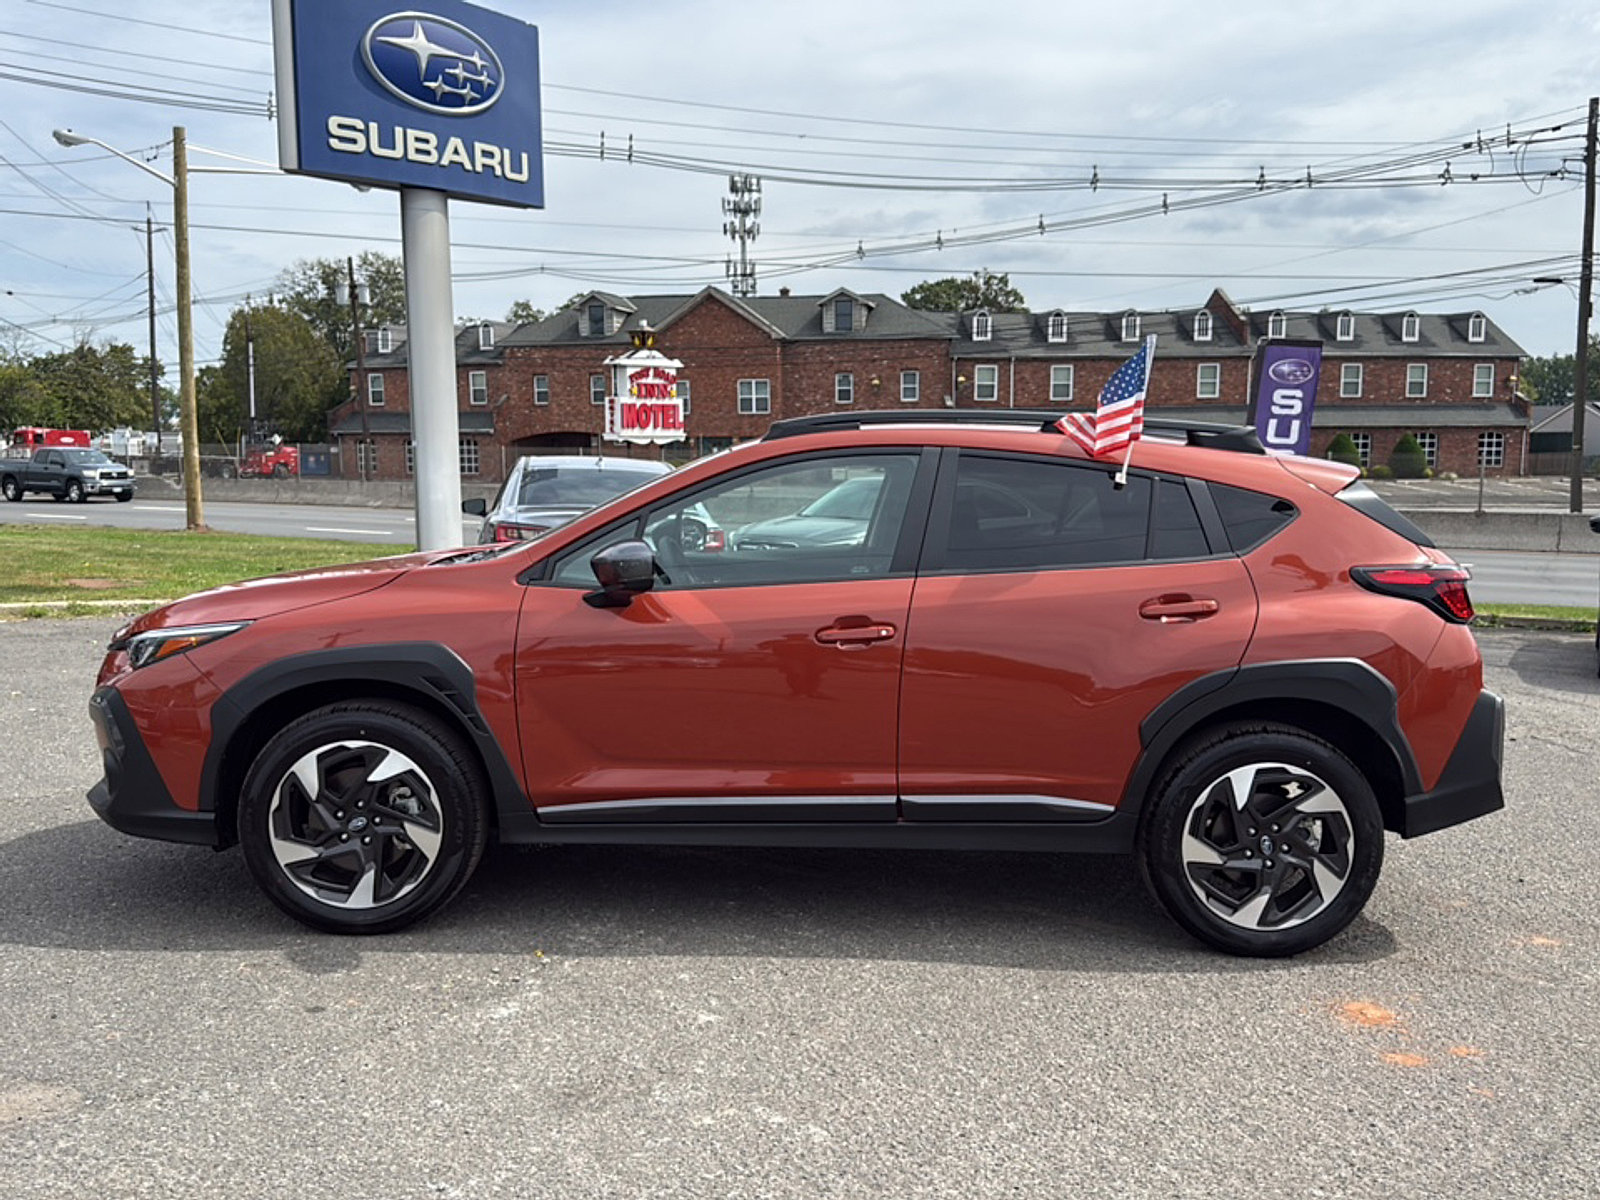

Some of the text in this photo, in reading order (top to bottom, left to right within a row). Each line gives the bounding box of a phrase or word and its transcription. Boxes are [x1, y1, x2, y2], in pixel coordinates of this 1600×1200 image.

[327, 115, 529, 183] SUBARU
[637, 383, 670, 399] INN
[621, 403, 684, 430] MOTEL
[1266, 388, 1304, 455] SU
